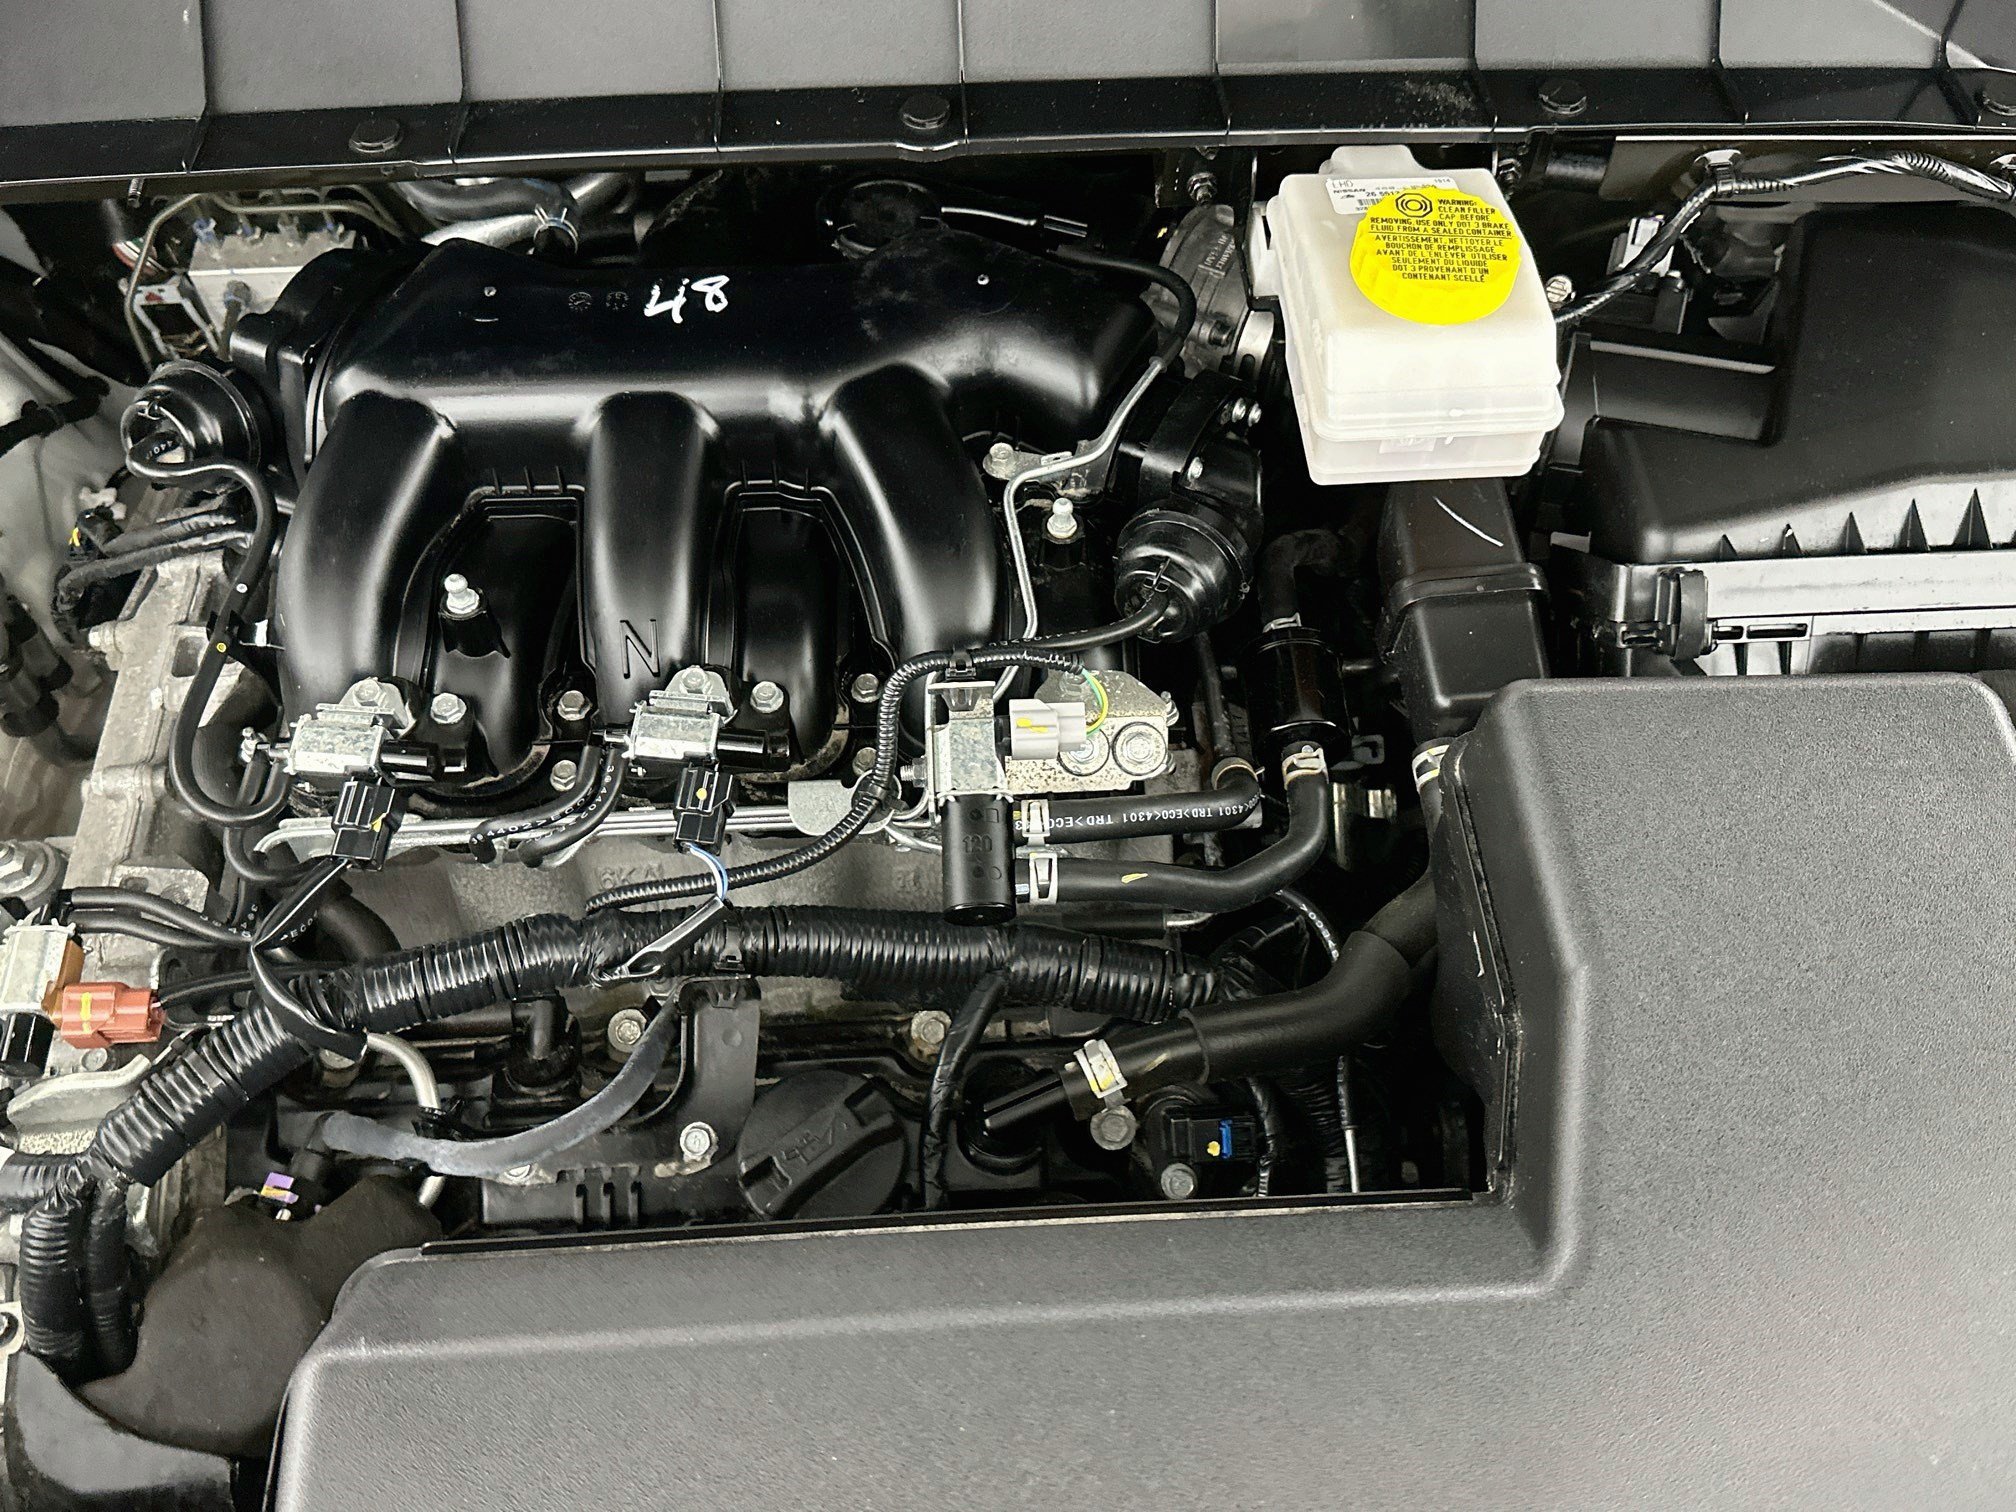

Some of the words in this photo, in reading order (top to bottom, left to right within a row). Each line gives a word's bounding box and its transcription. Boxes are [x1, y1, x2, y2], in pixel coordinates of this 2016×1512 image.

[1438, 245, 1495, 253] REMPLISSAGE
[1392, 257, 1440, 265] SEULEMENT
[1471, 253, 1507, 261] UTILISER
[1418, 266, 1468, 274] PROVENANT
[1402, 273, 1451, 281] CONTENANT
[1454, 274, 1485, 282] SCELLÉ
[644, 275, 729, 324] 48
[620, 619, 660, 679] N
[962, 834, 993, 854] 120
